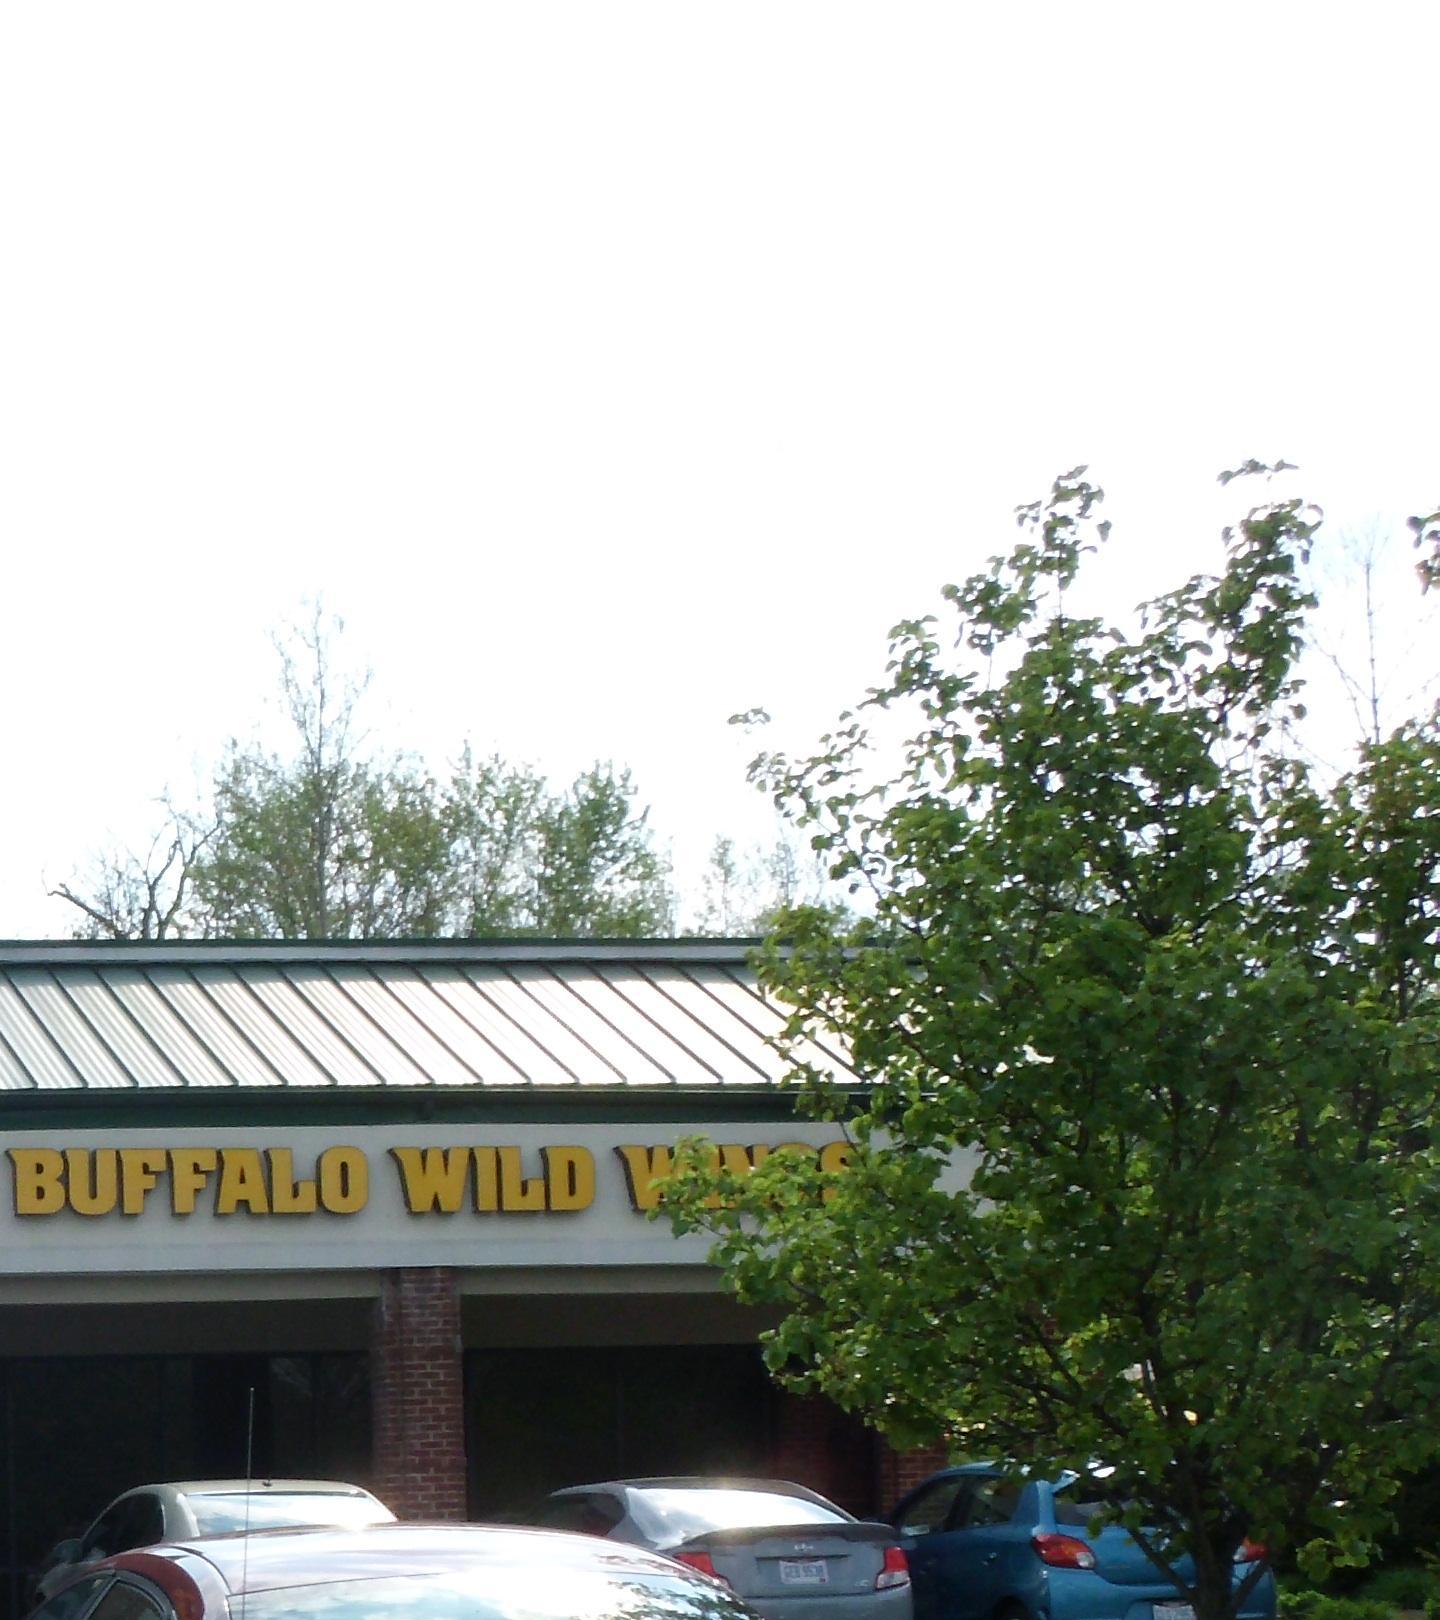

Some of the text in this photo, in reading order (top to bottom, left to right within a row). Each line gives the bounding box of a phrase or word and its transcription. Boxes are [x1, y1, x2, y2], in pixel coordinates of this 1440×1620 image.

[6, 1141, 858, 1216] BUFFALO WILD WNS
